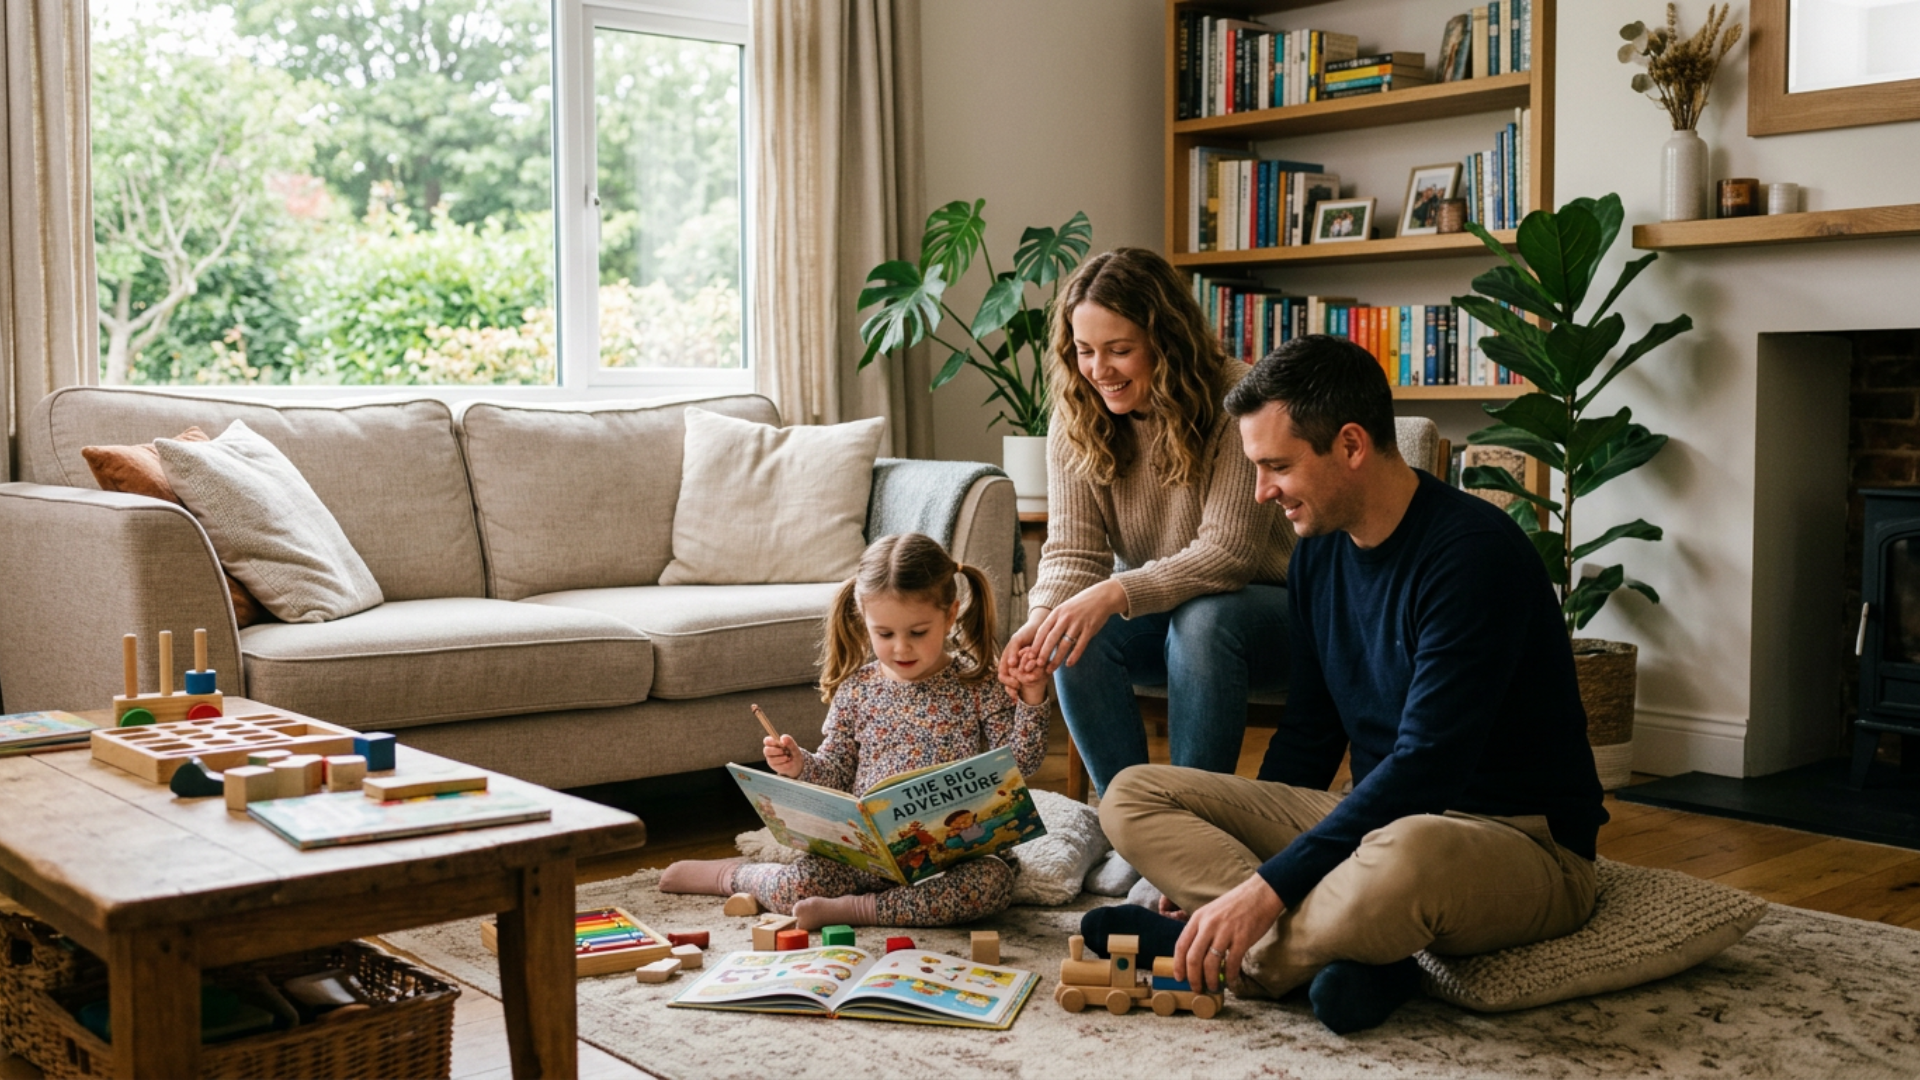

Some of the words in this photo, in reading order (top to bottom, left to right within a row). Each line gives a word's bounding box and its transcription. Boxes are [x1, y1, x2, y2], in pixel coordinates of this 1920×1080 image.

[893, 772, 1002, 821] ADVENTURE
[902, 779, 939, 799] THE
[943, 766, 976, 786] BIG
